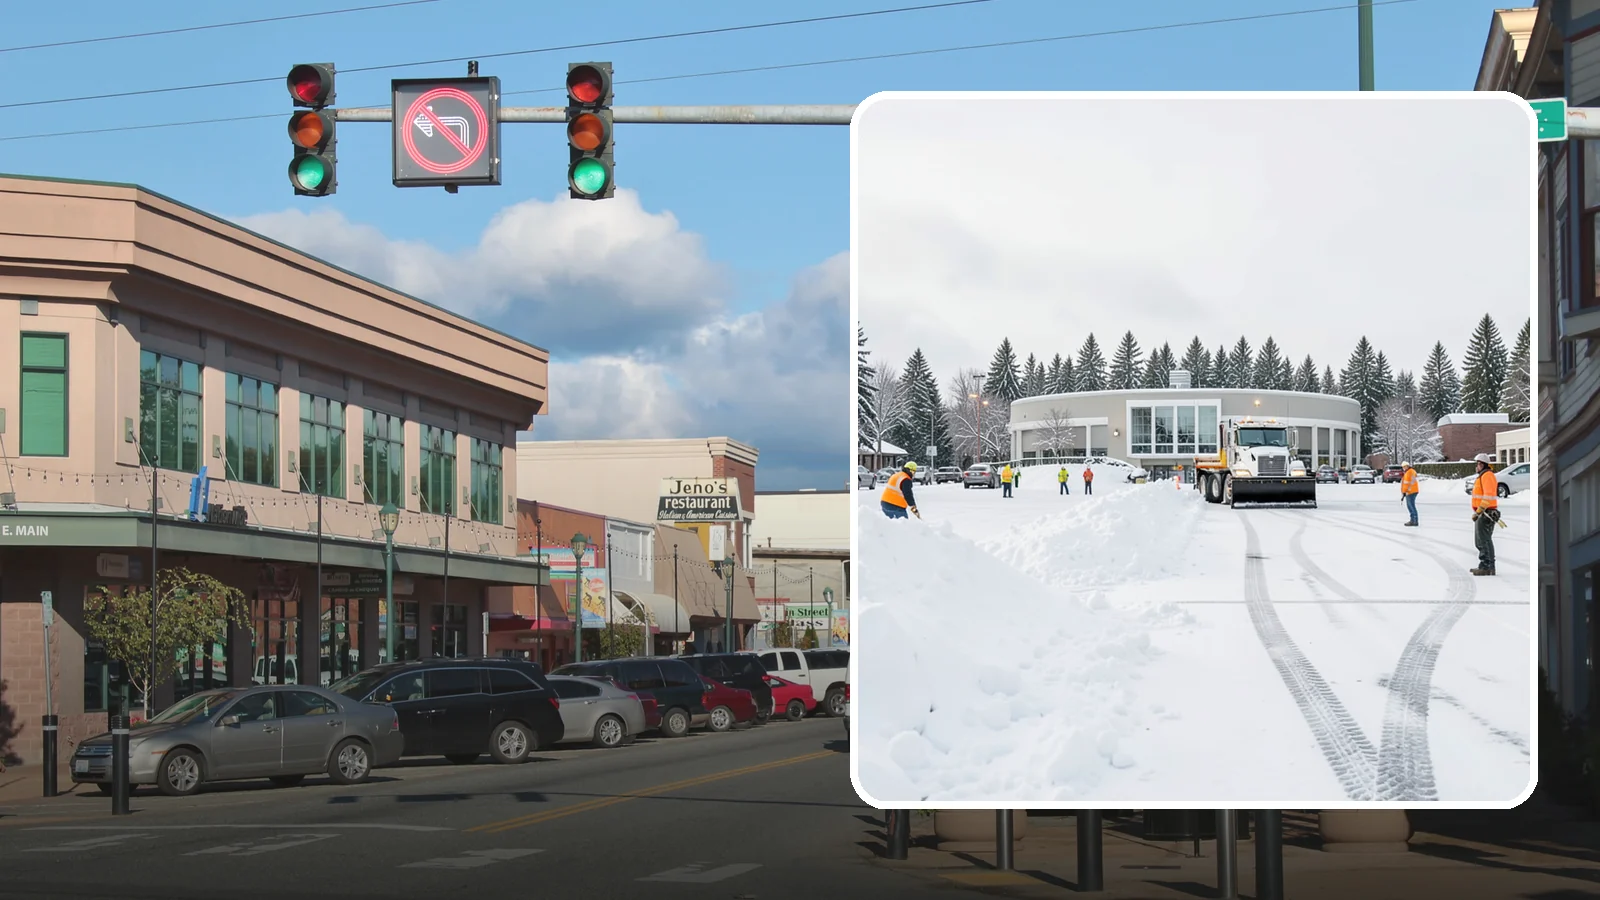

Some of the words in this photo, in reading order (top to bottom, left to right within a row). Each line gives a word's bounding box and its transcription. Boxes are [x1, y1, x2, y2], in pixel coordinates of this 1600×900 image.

[670, 480, 727, 494] Jeno's
[665, 497, 731, 509] restaurant
[658, 510, 681, 519] Italian
[686, 509, 714, 519] American
[715, 509, 737, 519] Cuisine
[3, 525, 13, 536] E.
[16, 525, 49, 536] MAIN
[797, 607, 829, 617] Street
